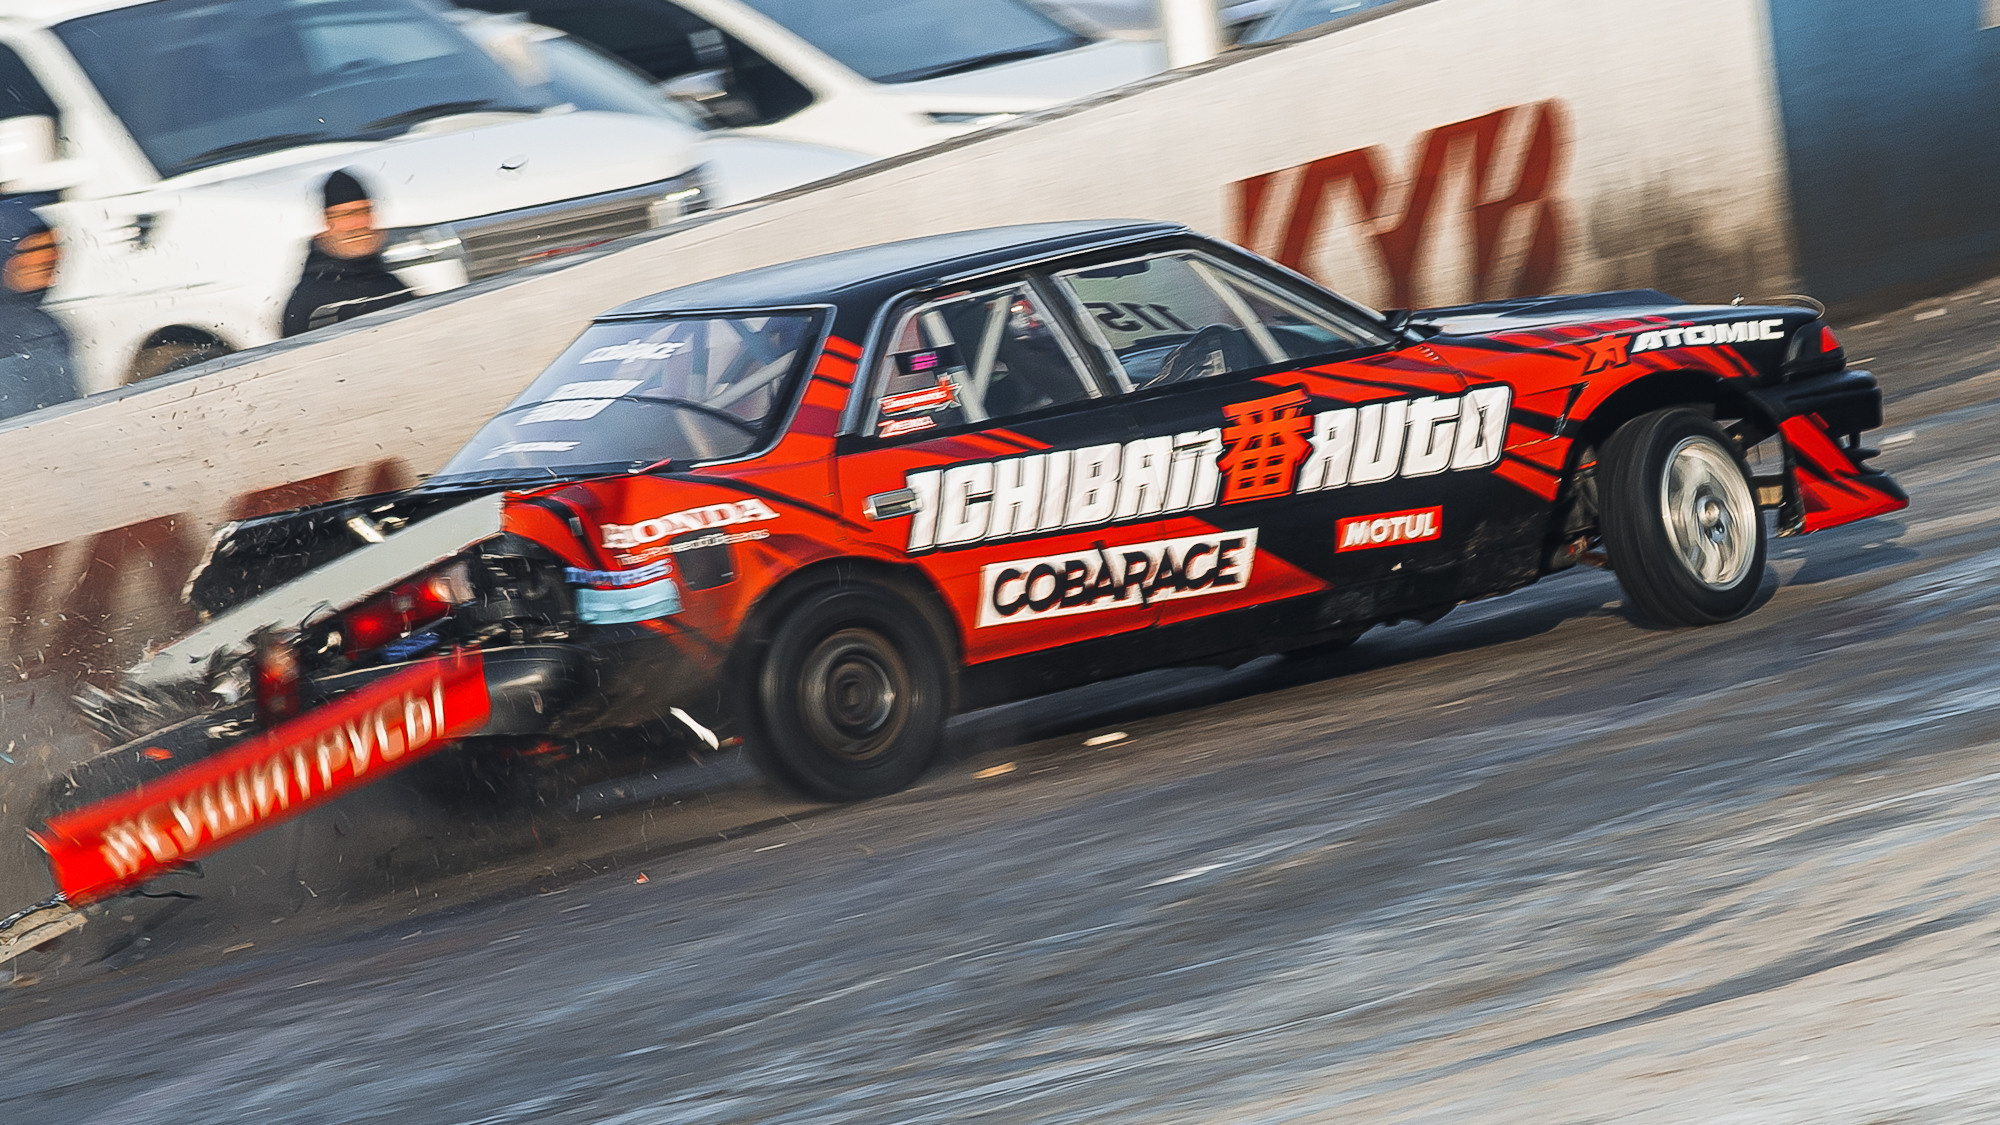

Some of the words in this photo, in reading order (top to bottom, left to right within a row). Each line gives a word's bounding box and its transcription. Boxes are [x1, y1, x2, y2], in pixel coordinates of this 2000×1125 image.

[1631, 318, 1785, 353] ATOMIC
[1220, 386, 1313, 505] 番
[600, 497, 781, 549] HONDA
[1343, 511, 1437, 547] MOTUL
[992, 536, 1249, 616] COBARACE
